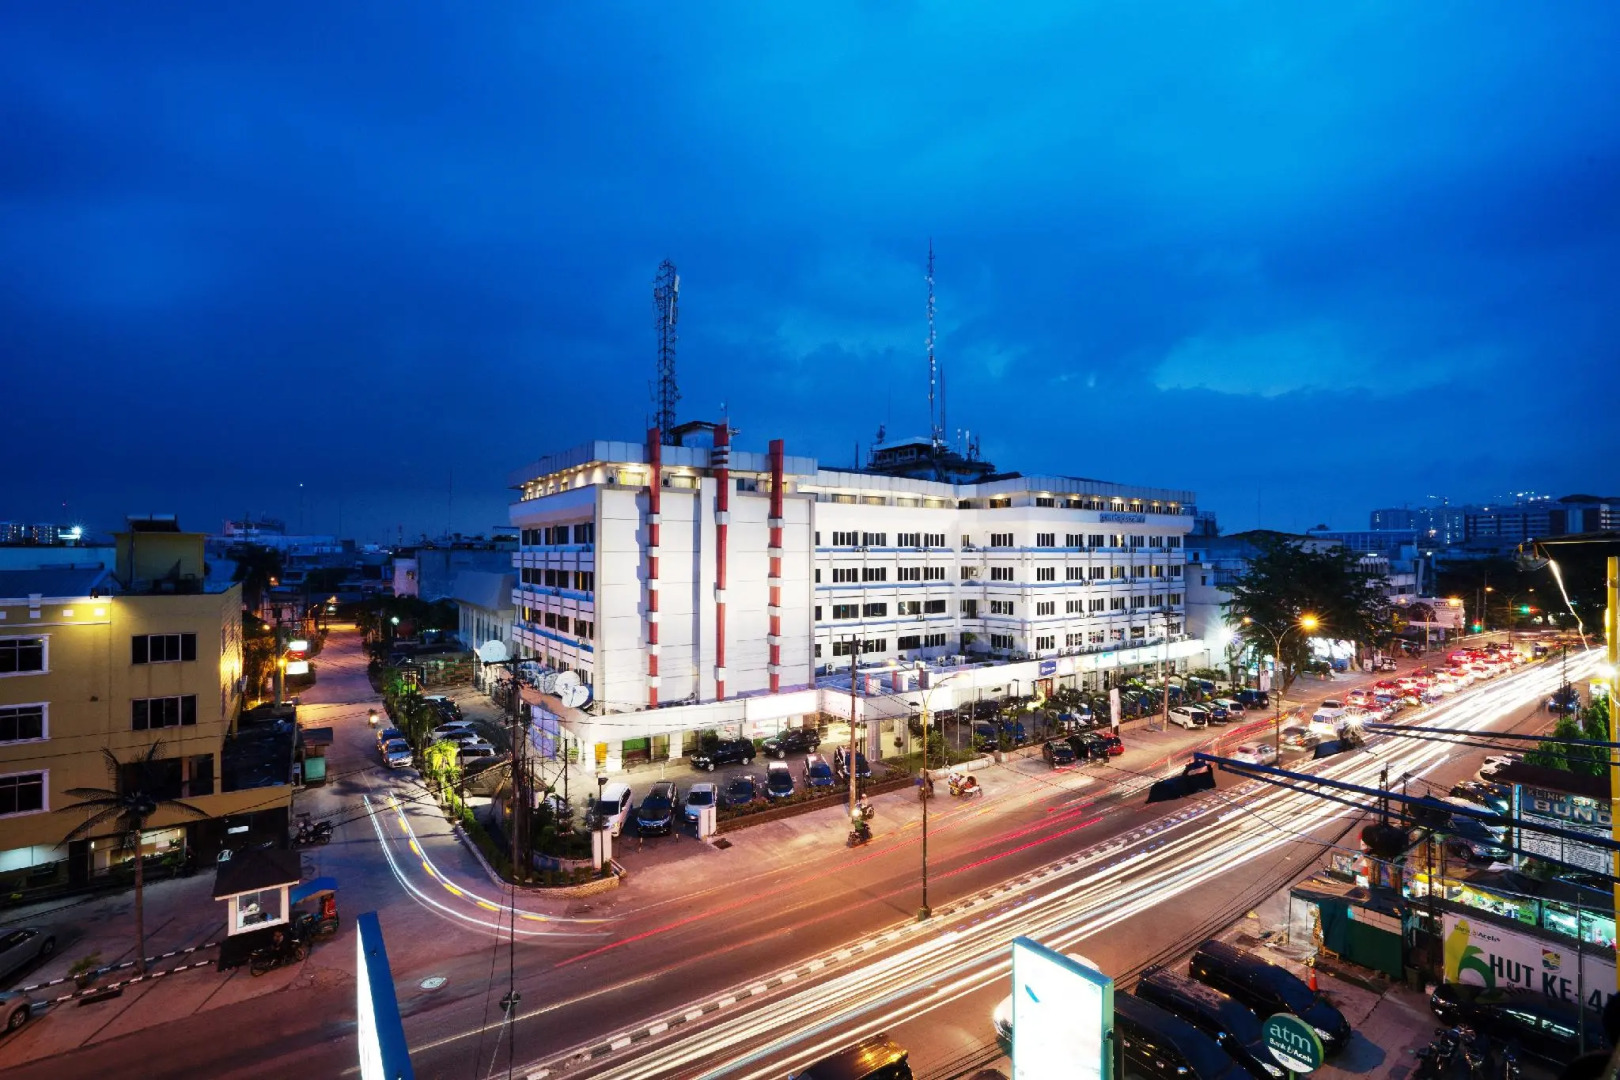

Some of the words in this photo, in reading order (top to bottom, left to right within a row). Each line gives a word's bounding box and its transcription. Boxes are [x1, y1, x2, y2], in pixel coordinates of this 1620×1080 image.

[1489, 953, 1534, 988] HUT
[1270, 1023, 1311, 1053] atm
[1270, 1037, 1286, 1050] Bank
[1293, 1049, 1312, 1064] Aceh
